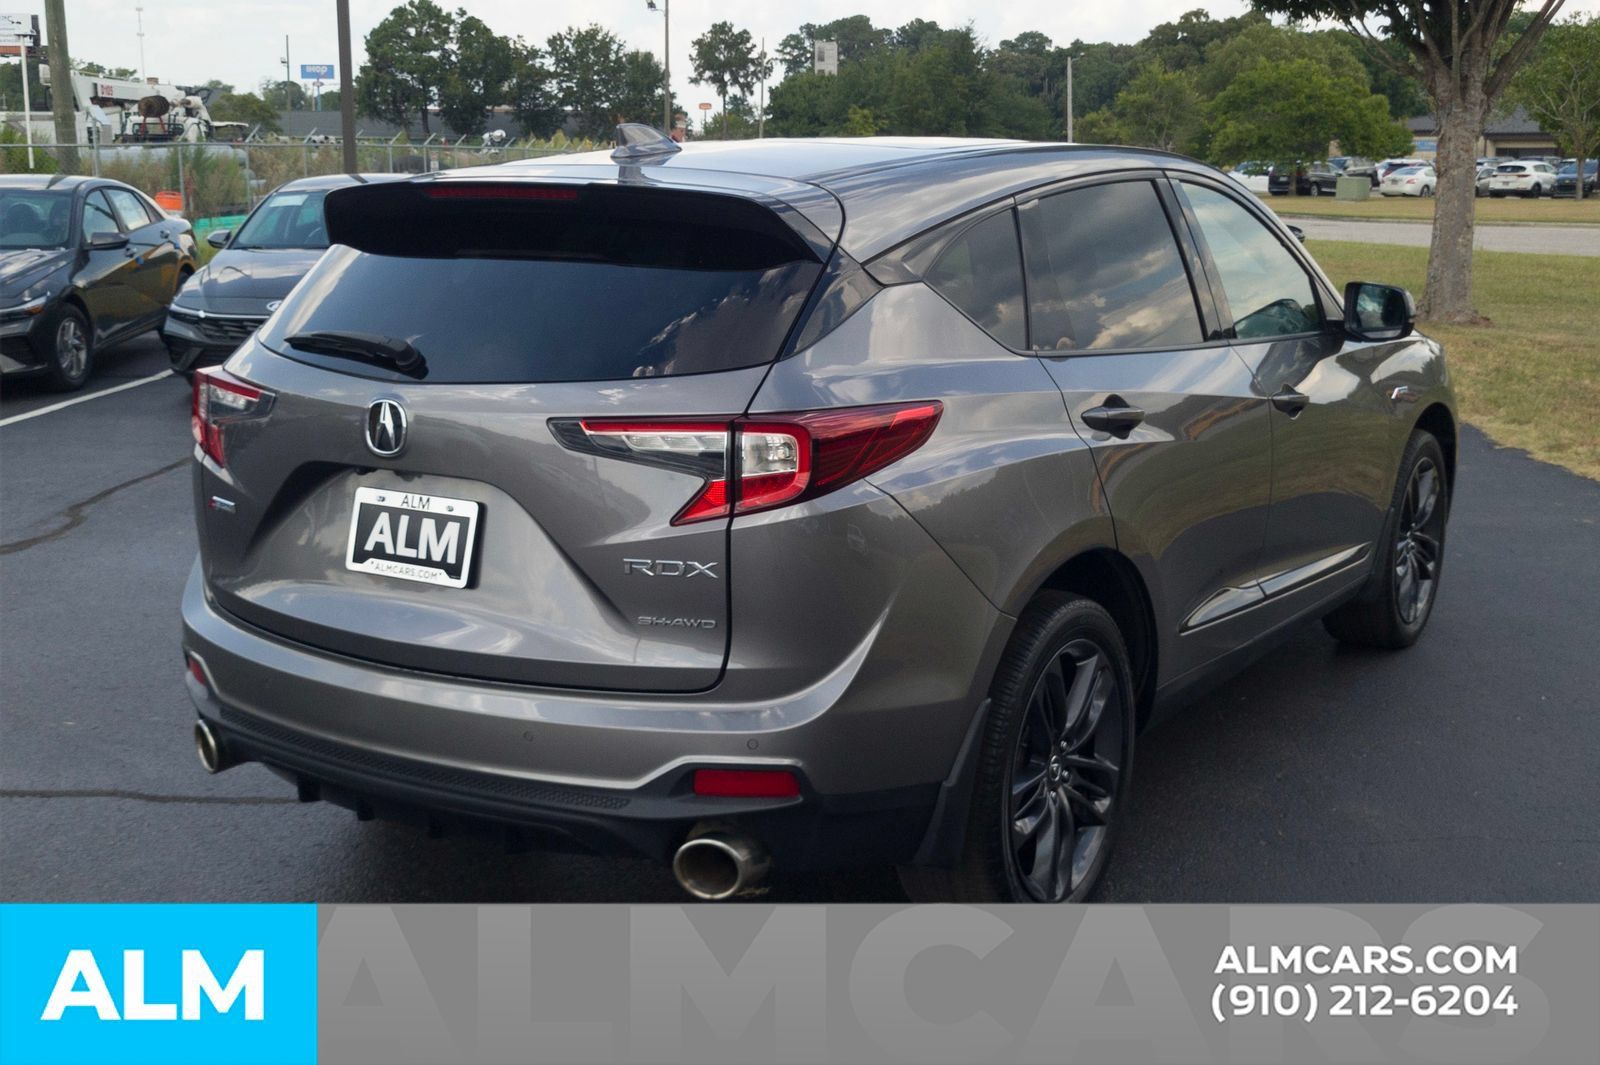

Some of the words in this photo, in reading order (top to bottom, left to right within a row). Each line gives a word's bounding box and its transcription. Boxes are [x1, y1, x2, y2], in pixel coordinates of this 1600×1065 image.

[400, 494, 430, 510] ALM
[364, 511, 460, 564] ALM
[623, 558, 719, 579] RDX
[638, 616, 716, 629] SH-AWD
